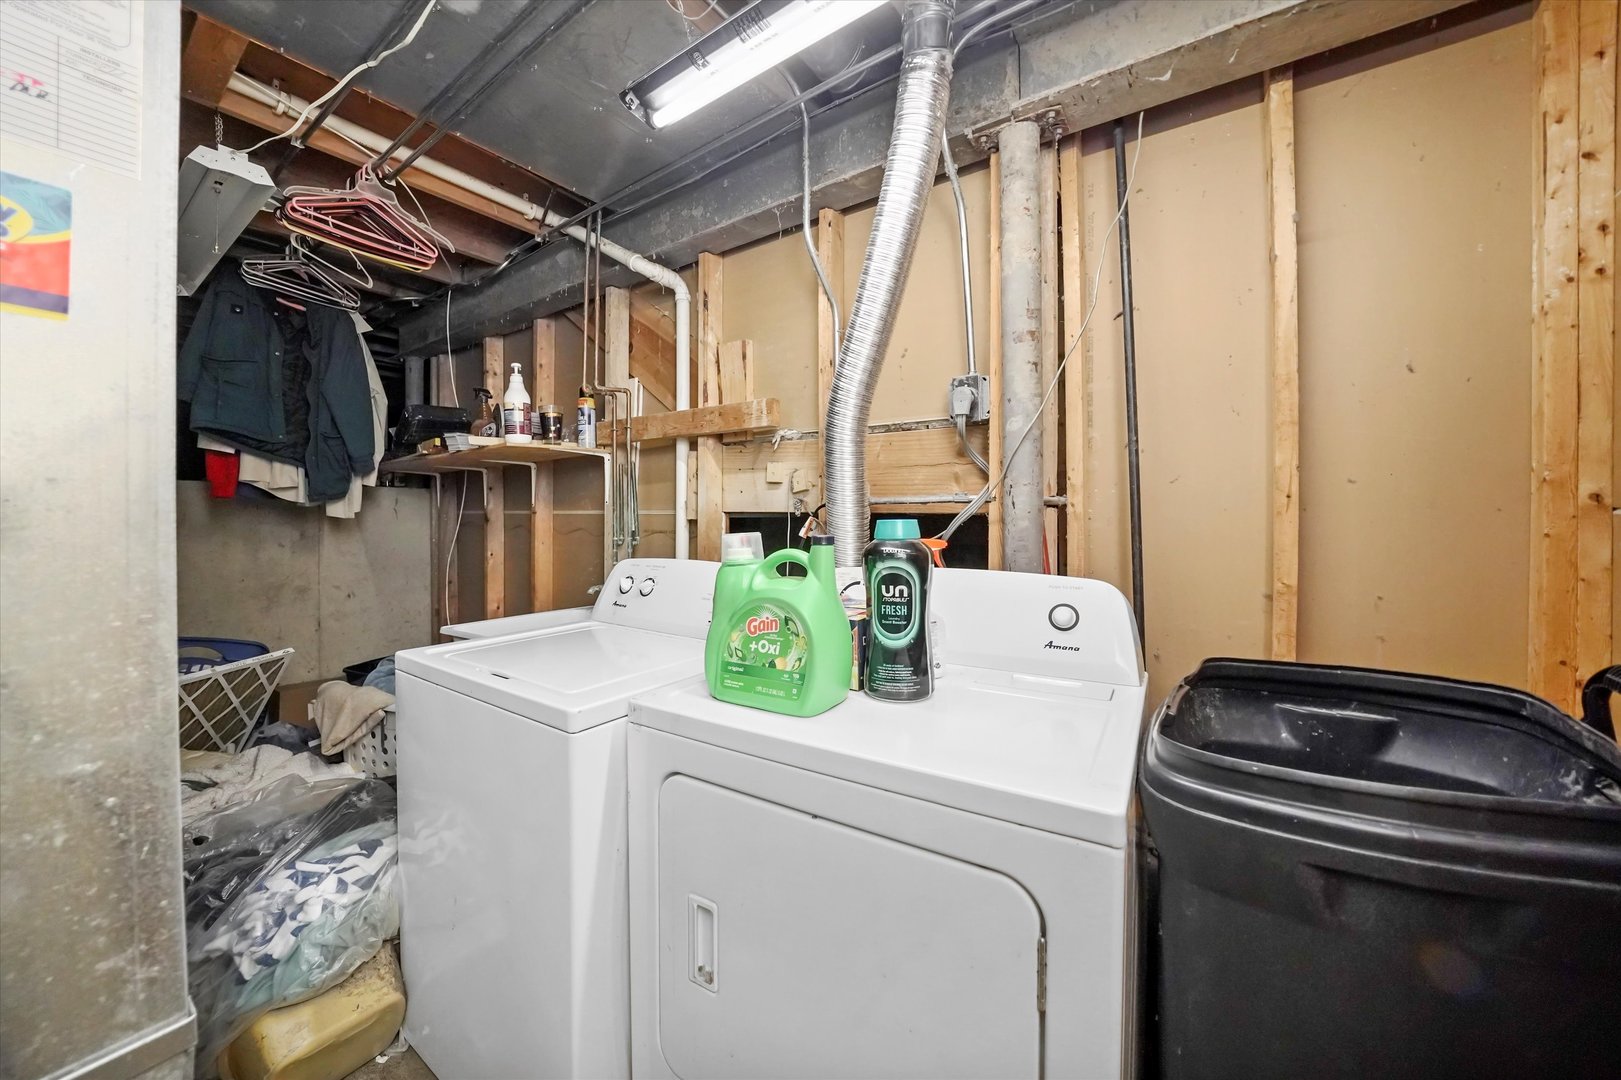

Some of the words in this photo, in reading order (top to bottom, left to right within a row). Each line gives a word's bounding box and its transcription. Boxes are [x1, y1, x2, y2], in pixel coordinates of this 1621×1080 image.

[881, 604, 908, 616] FRESH
[747, 617, 779, 636] Gain
[749, 639, 781, 655] +Oxi
[1043, 640, 1081, 652] Amana
